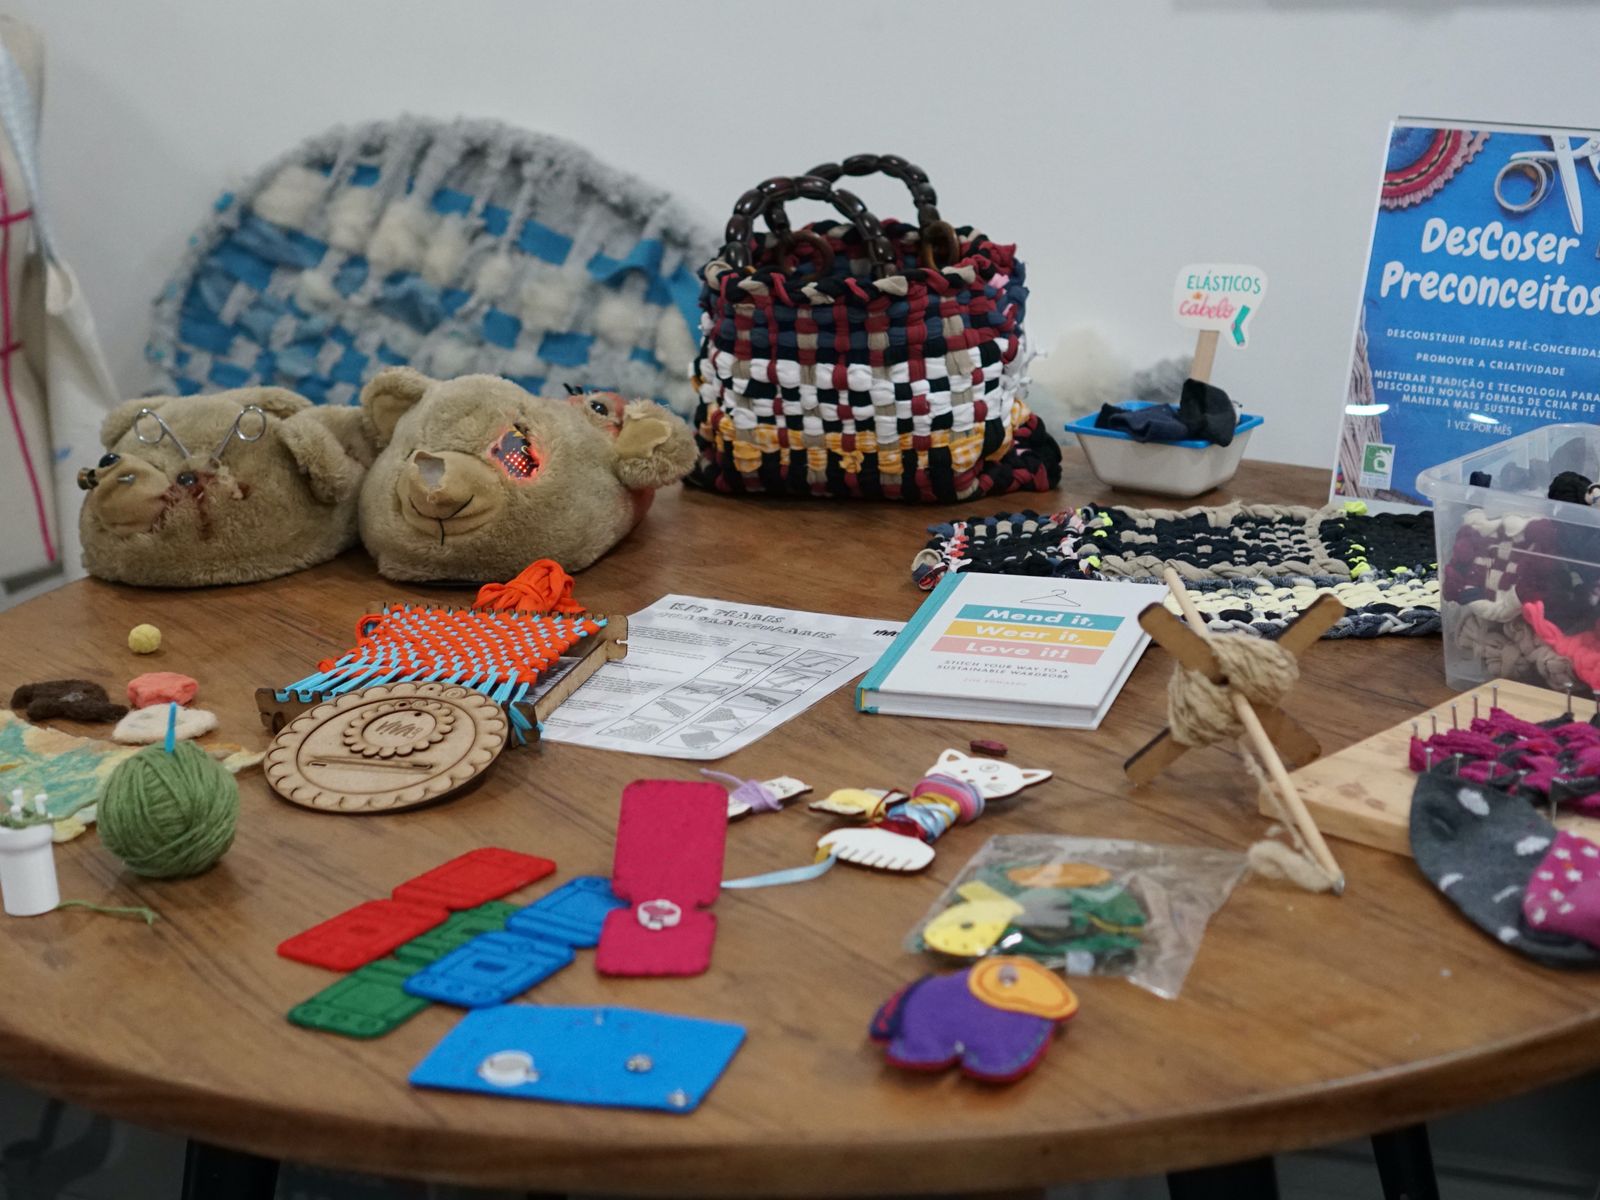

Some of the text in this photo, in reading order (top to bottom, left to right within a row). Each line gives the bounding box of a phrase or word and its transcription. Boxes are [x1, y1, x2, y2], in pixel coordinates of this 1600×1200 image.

[1421, 217, 1580, 265] DesCoser
[1186, 270, 1262, 295] ELÁSTICOS
[1380, 260, 1600, 316] Preconceitos
[1386, 328, 1466, 344] DESCONSTRUIR
[1469, 336, 1505, 349] IDEIAS
[1415, 352, 1566, 377] PROMOVER A CRIATIVIDADE
[1374, 369, 1600, 402] MISTURAR TRADIÇÃO E TECNOLOGIA PARA
[1376, 381, 1596, 413] DESCOBRIR NOVAS FORMAS DE CRIAR DE
[1401, 394, 1562, 421] MANEIRA MAIS SUSTENTÁVEL.
[1454, 420, 1471, 432] VEZ
[1472, 422, 1493, 434] POR
[1493, 424, 1513, 436] MÊS
[669, 601, 708, 614] KIT
[983, 609, 1095, 627] Mend it,
[975, 625, 1085, 643] Wear it,
[965, 641, 1071, 659] Love it!
